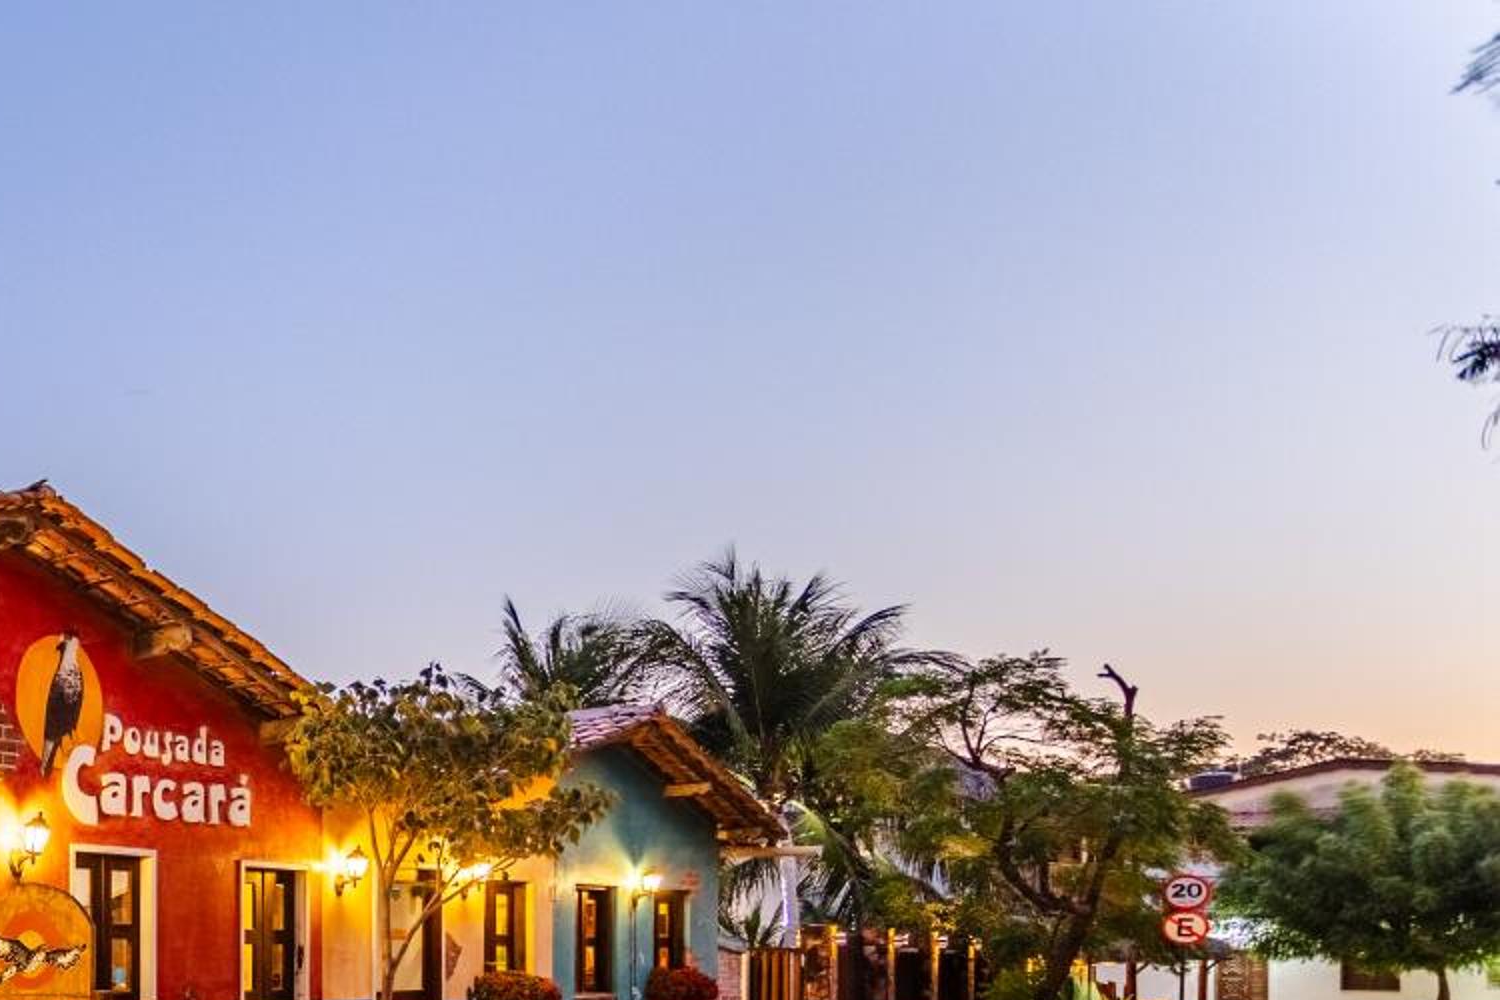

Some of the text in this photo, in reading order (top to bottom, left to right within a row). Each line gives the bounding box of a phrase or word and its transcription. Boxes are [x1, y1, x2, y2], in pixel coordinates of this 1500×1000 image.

[102, 712, 226, 767] Pousada
[61, 744, 252, 827] Carcará
[1171, 883, 1203, 899] 20
[1177, 917, 1195, 937] E
